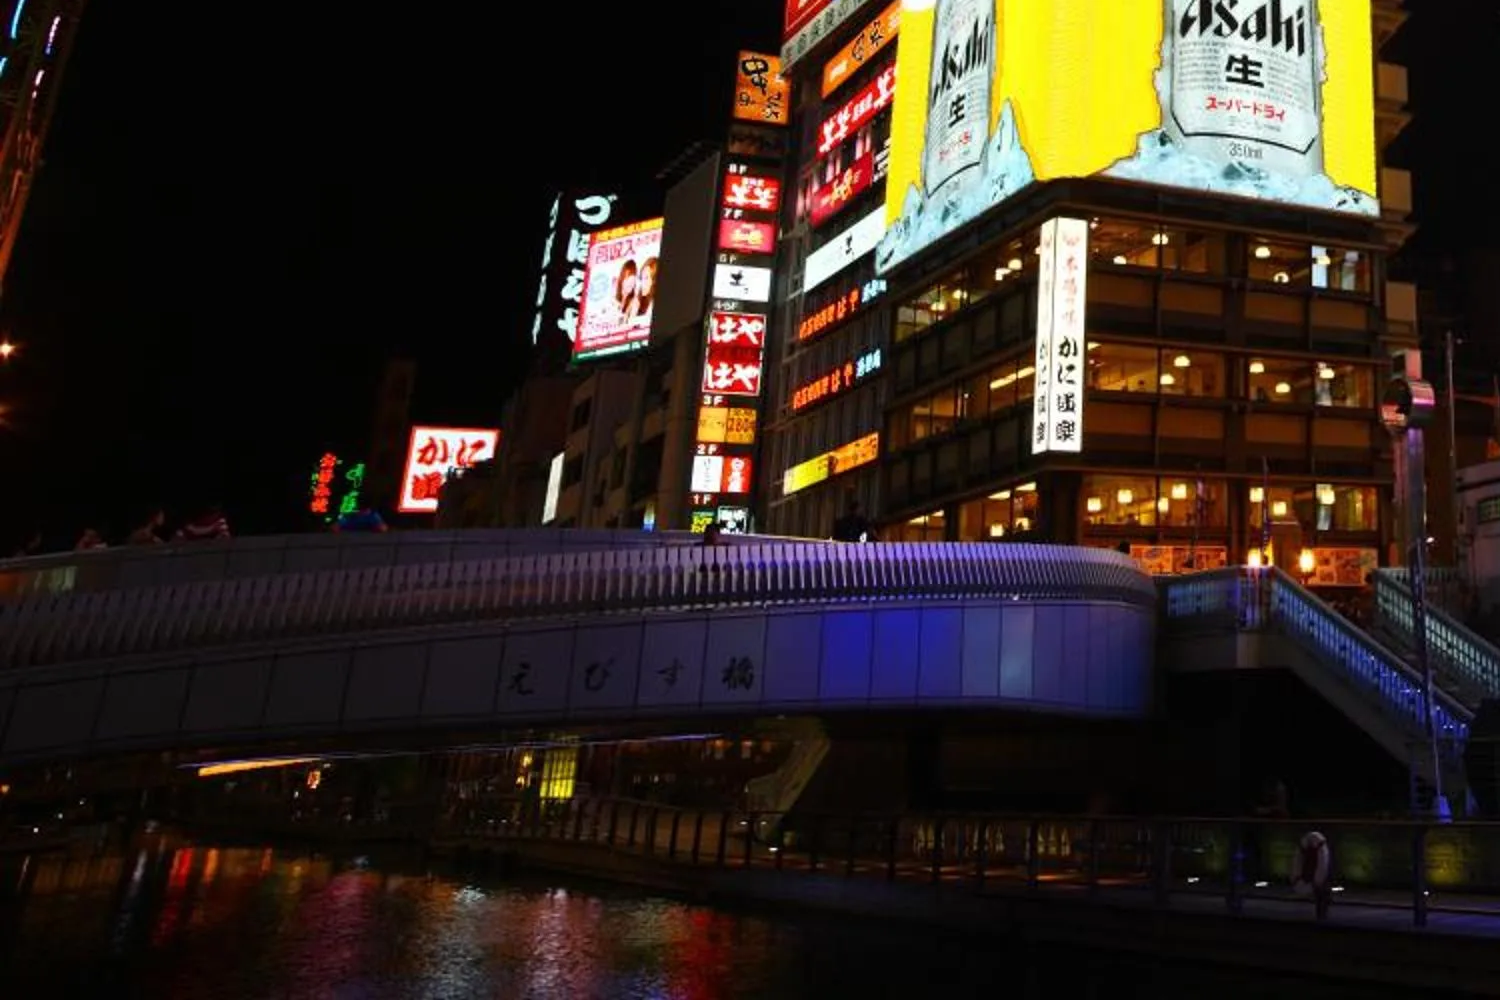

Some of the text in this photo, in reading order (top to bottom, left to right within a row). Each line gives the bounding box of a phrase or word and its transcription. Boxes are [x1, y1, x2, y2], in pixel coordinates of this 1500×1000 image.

[1225, 54, 1264, 89] 生
[949, 94, 966, 129] 生
[1205, 96, 1286, 122] スーパードライ
[416, 436, 487, 467] かに
[507, 655, 756, 696] えびす橋
